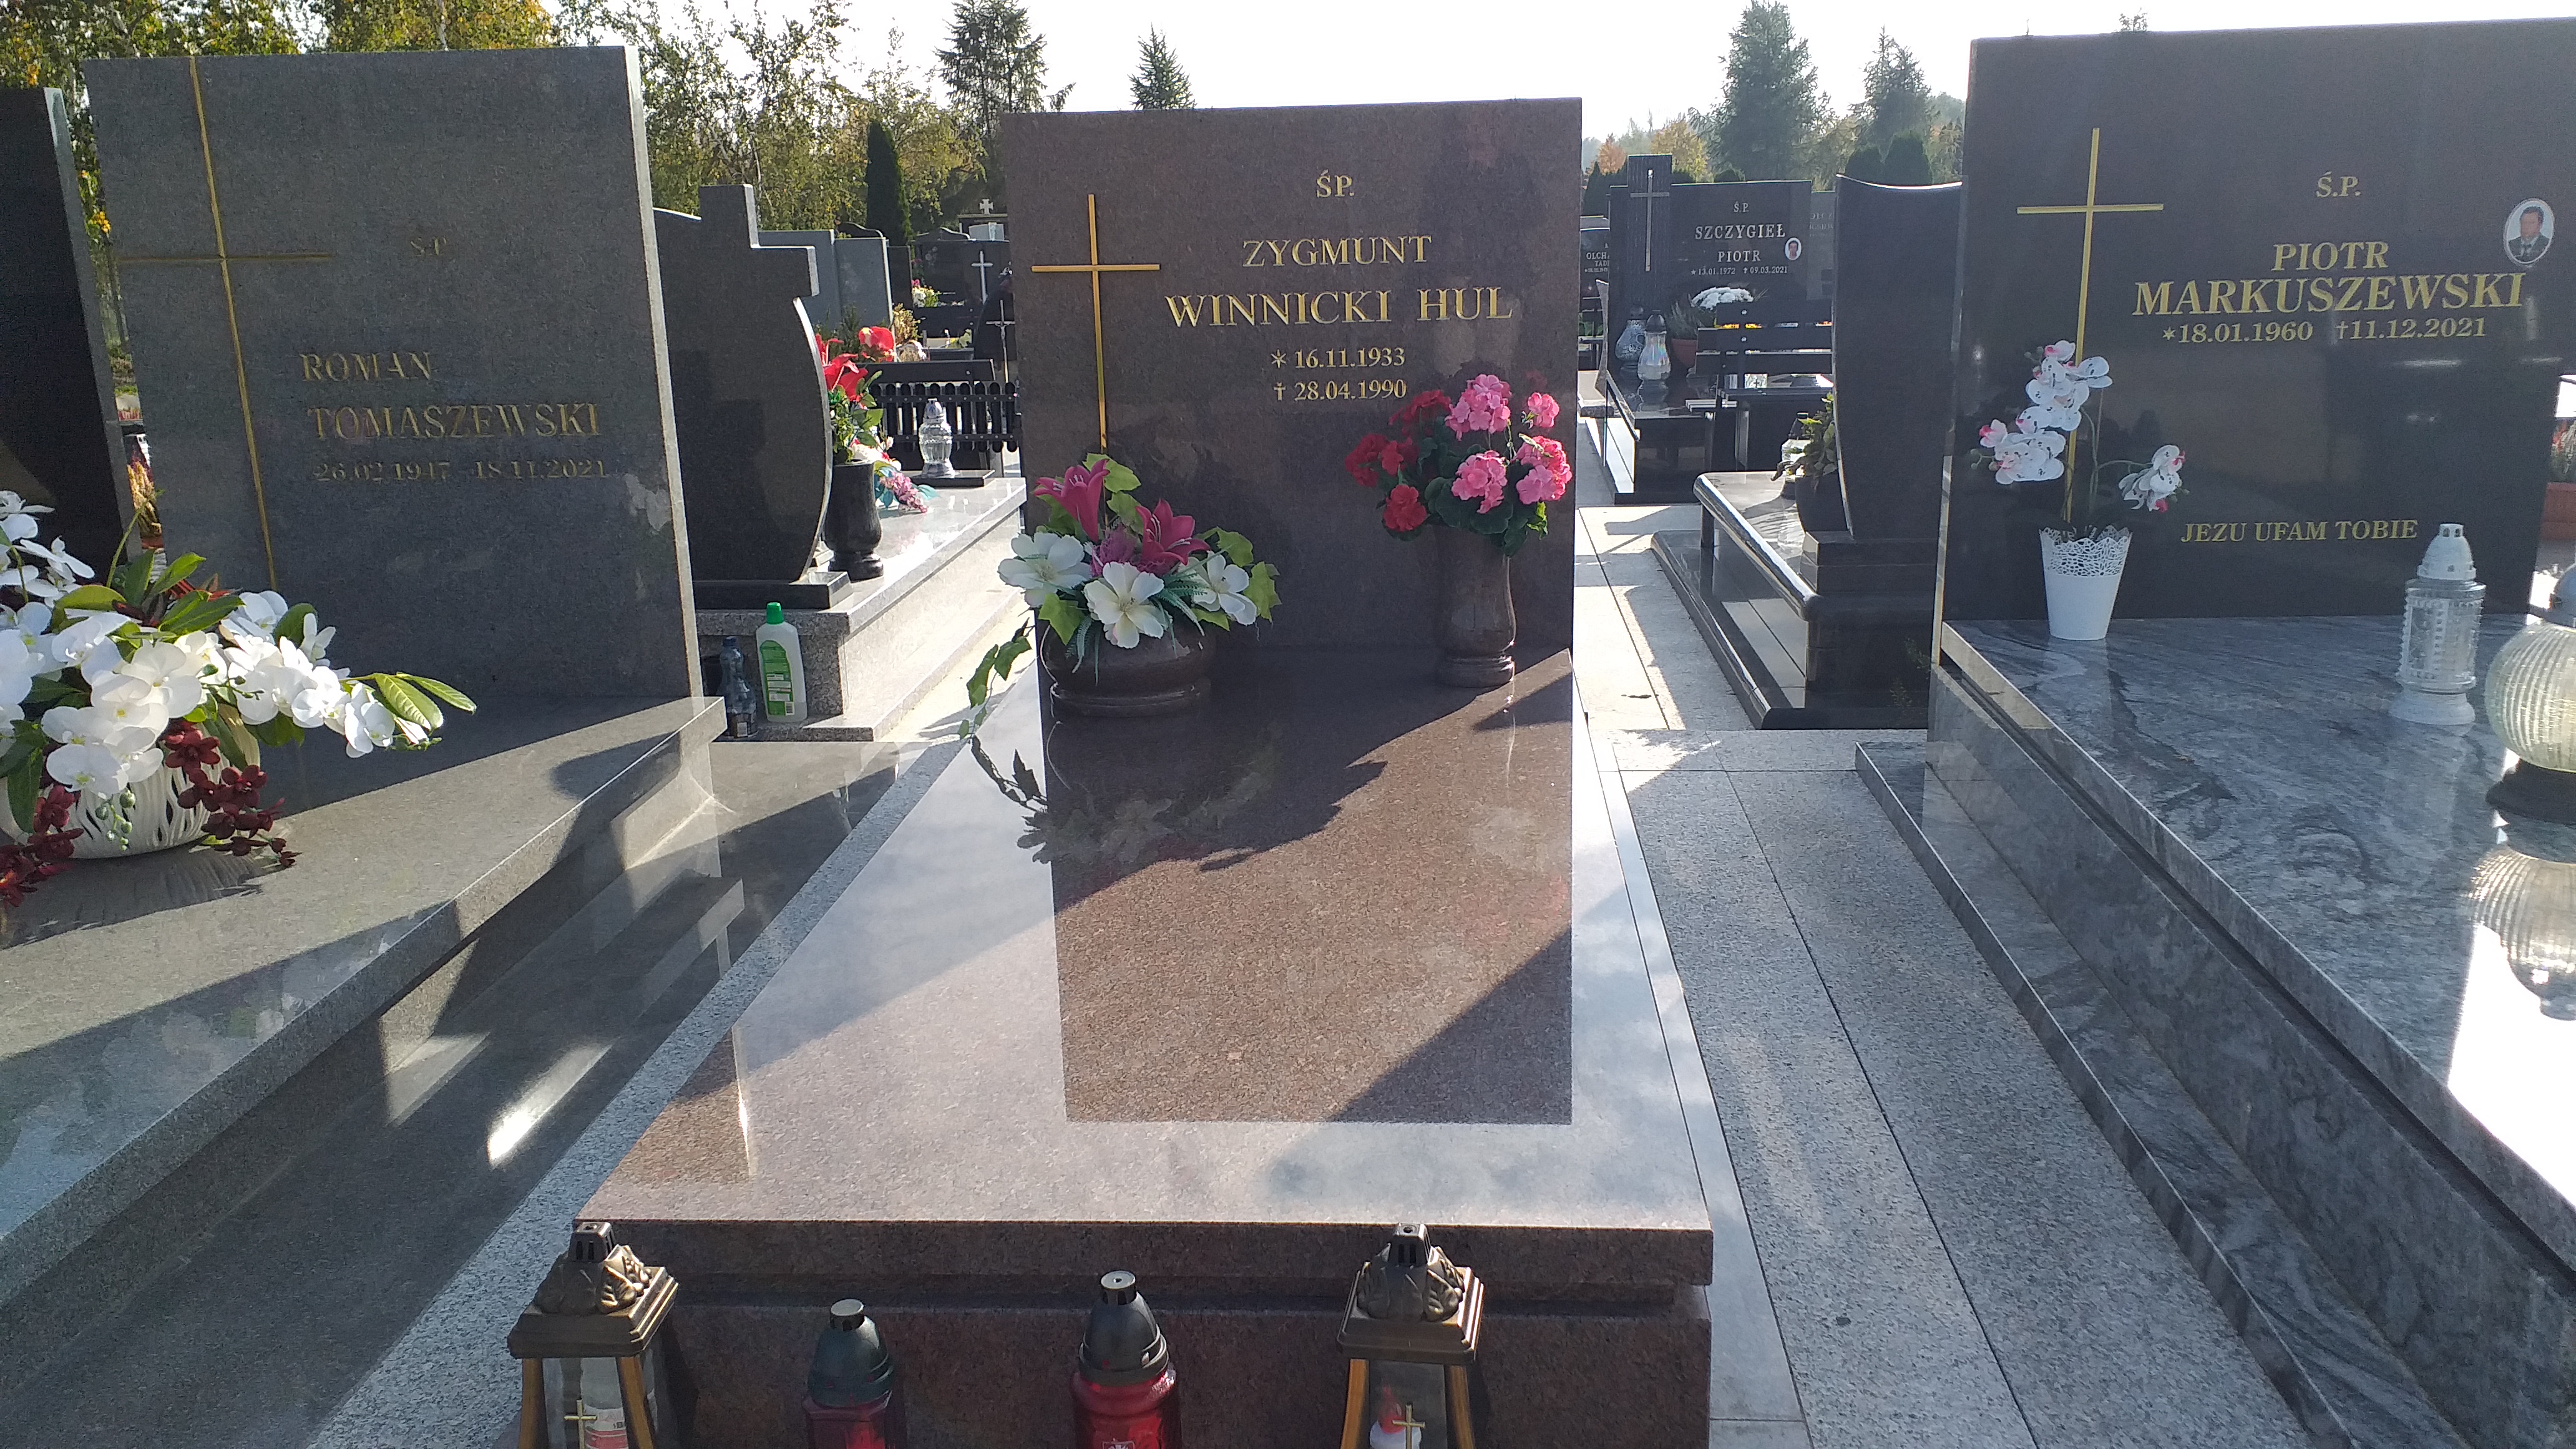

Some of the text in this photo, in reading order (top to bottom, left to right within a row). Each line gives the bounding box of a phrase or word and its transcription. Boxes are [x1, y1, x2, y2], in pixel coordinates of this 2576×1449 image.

[2315, 172, 2362, 198] Ś.P.
[1694, 223, 1786, 240] SZCZYGIEŁ
[1242, 235, 1432, 268] ZYGMUNT
[1717, 250, 1761, 263] PIOTR
[2271, 241, 2389, 271] PIOTR
[1698, 266, 1788, 276] 13.01.1972 09.03.2021
[2132, 272, 2526, 316] MARKUSZEWSKI
[1165, 286, 1513, 328] WINNICKI HUL
[2178, 321, 2313, 343] 18.01.1960
[299, 351, 439, 382] ROMAN
[1294, 346, 1406, 369] 16.11.1933
[1294, 379, 1407, 401] 28.04.1990
[308, 402, 603, 439] TOMASZEWSKI
[2180, 519, 2419, 543] JEZU UFAM TOBIE
